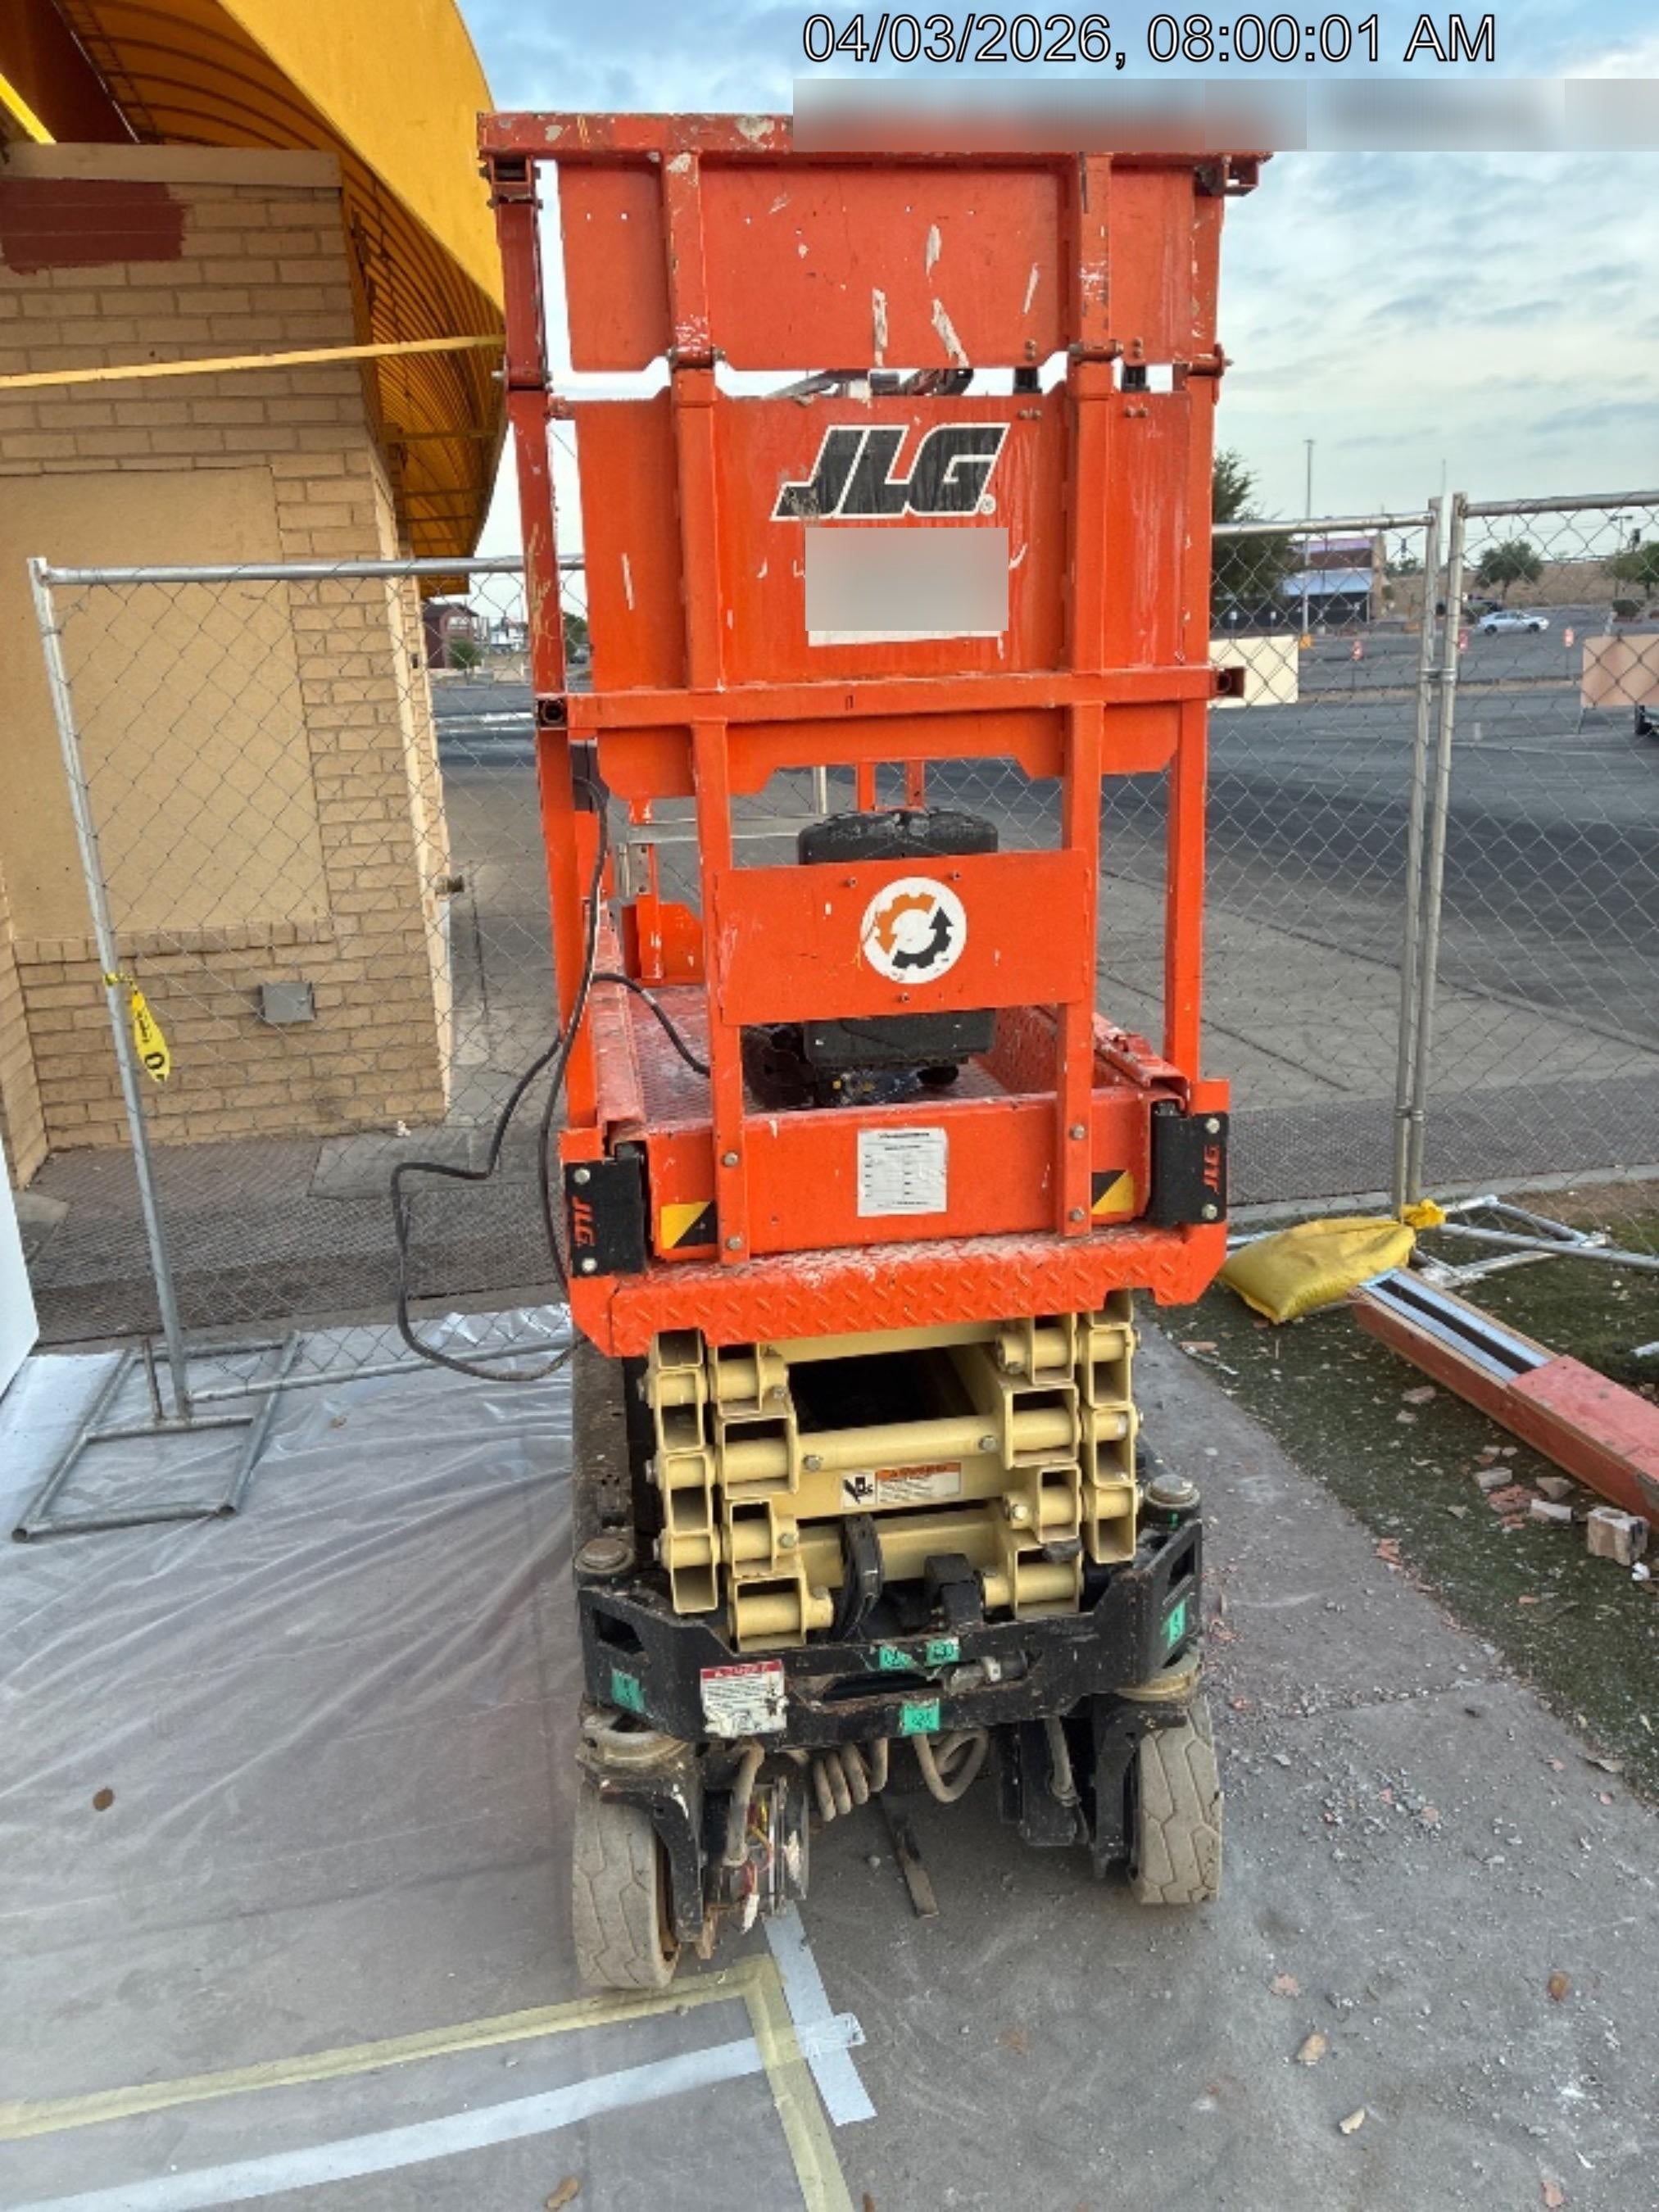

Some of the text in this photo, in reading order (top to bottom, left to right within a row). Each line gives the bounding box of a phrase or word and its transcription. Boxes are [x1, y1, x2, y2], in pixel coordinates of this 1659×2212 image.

[771, 423, 1009, 521] JLG
[1203, 1145, 1220, 1195] JLG
[572, 1196, 596, 1247] JLG
